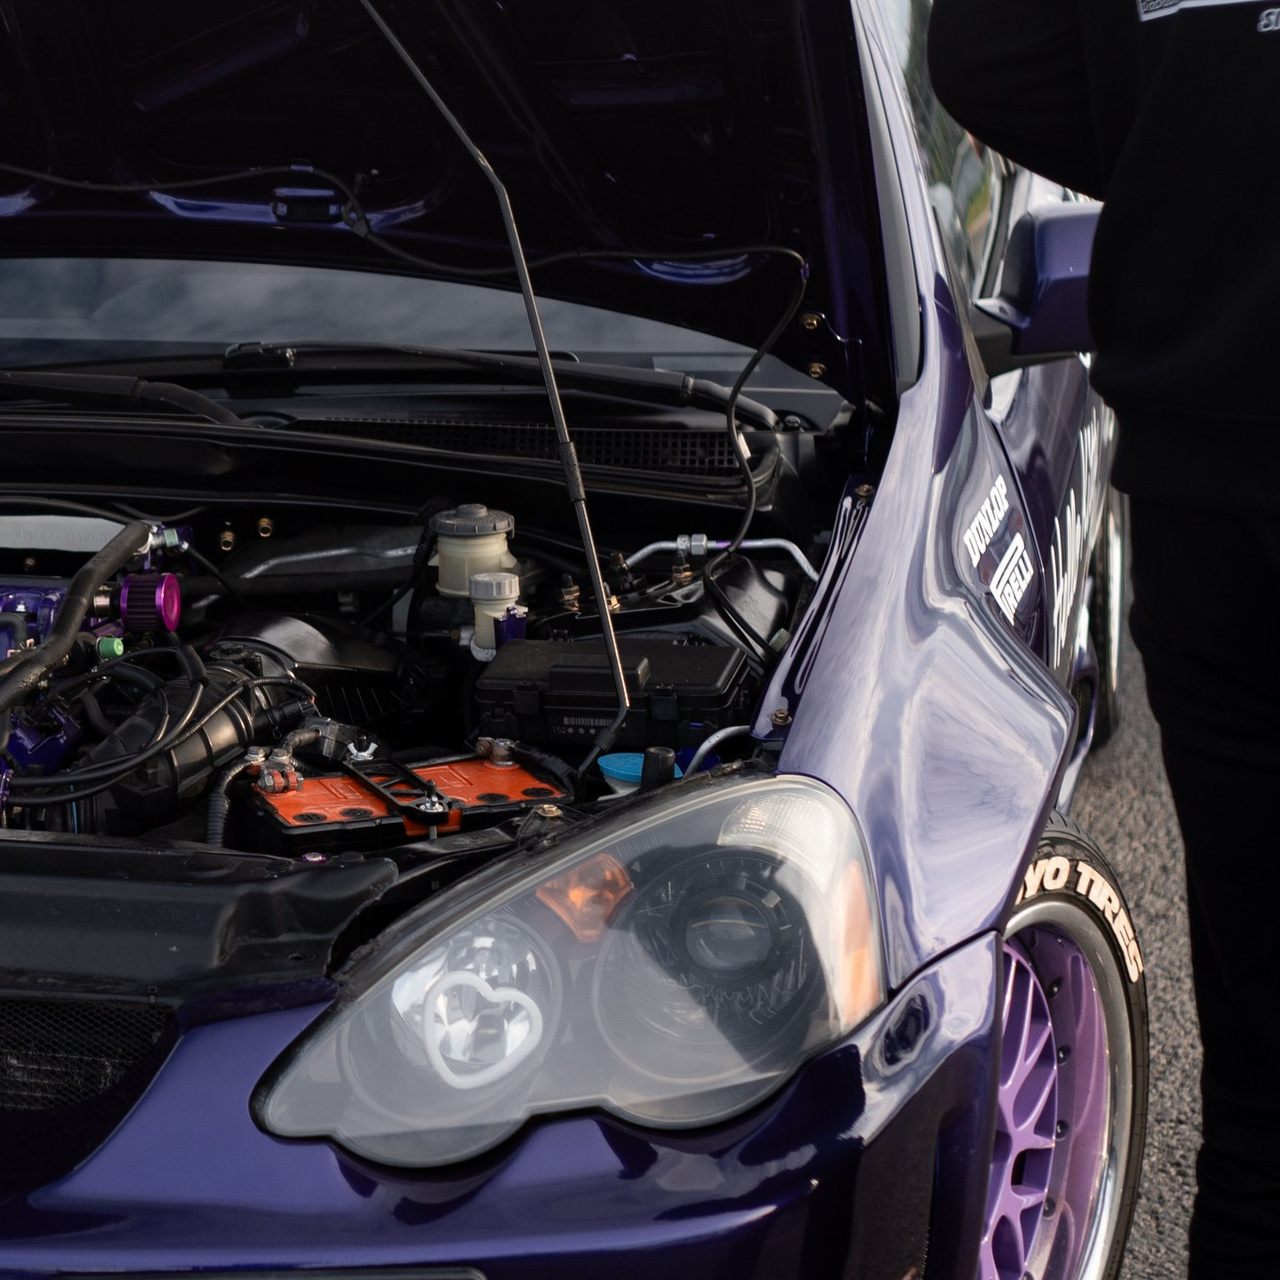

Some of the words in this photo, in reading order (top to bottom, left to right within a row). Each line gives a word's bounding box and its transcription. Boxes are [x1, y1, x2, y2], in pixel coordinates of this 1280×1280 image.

[963, 474, 1010, 568] DUNLOP
[989, 532, 1034, 626] PIRELLI
[1015, 856, 1070, 905] YO
[1076, 861, 1143, 982] TIRES
